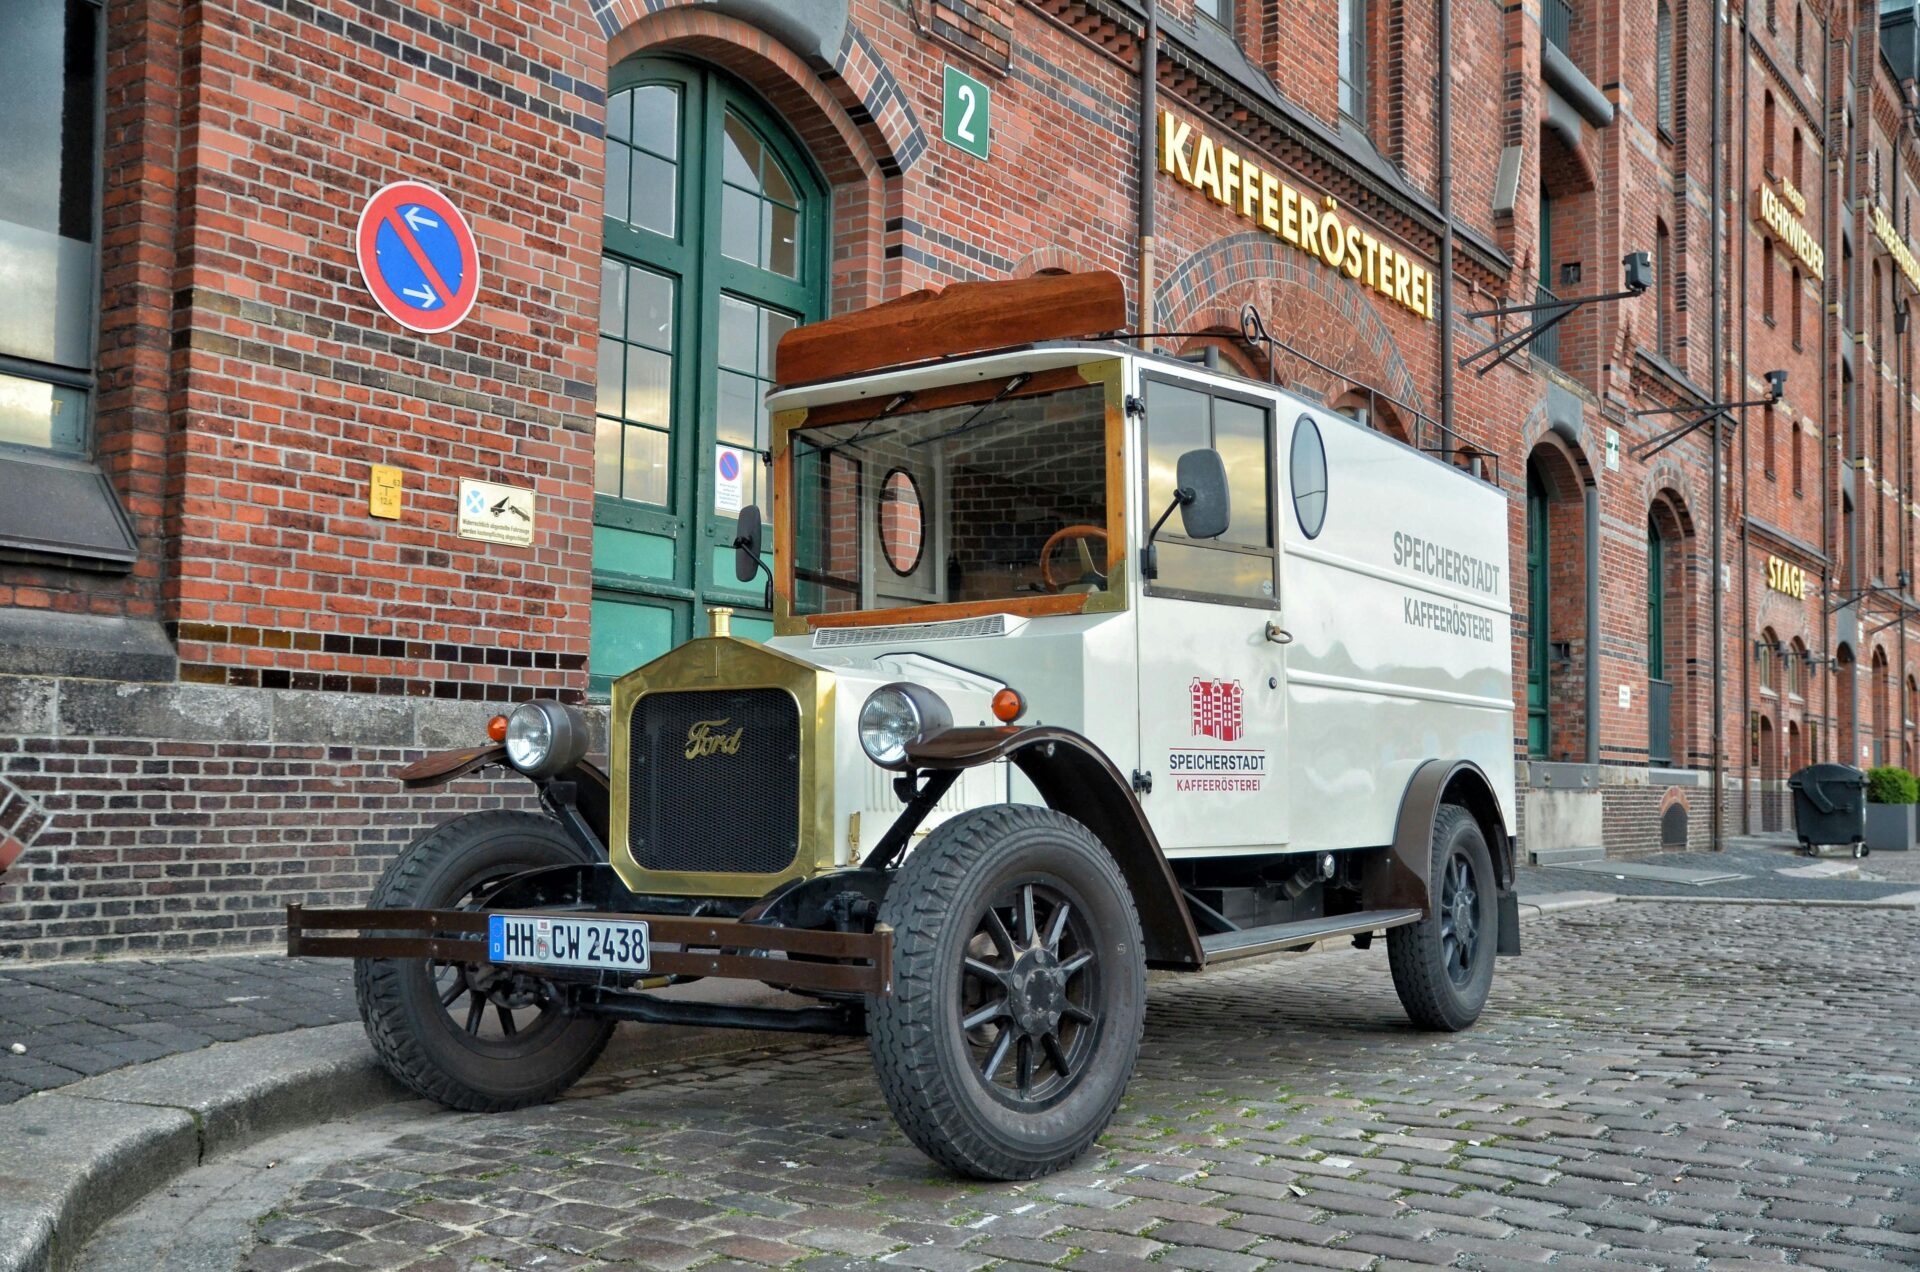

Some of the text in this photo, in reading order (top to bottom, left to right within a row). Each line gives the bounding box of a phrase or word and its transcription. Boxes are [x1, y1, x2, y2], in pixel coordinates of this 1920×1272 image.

[958, 85, 976, 143] 2
[1159, 110, 1433, 321] KAFFEERÖSTEREI
[1761, 182, 1825, 281] KEHRWIEDER
[1393, 530, 1500, 596] SPEICHERSTADT
[1768, 555, 1806, 600] STAGE
[1404, 596, 1493, 643] KAFFEERÖSTEREI
[685, 717, 744, 760] Ford
[1169, 754, 1265, 771] SPEICHERSTADT
[1176, 777, 1261, 792] KAFFEERÖSTEREI
[494, 923, 645, 964] D HH CW 2438
